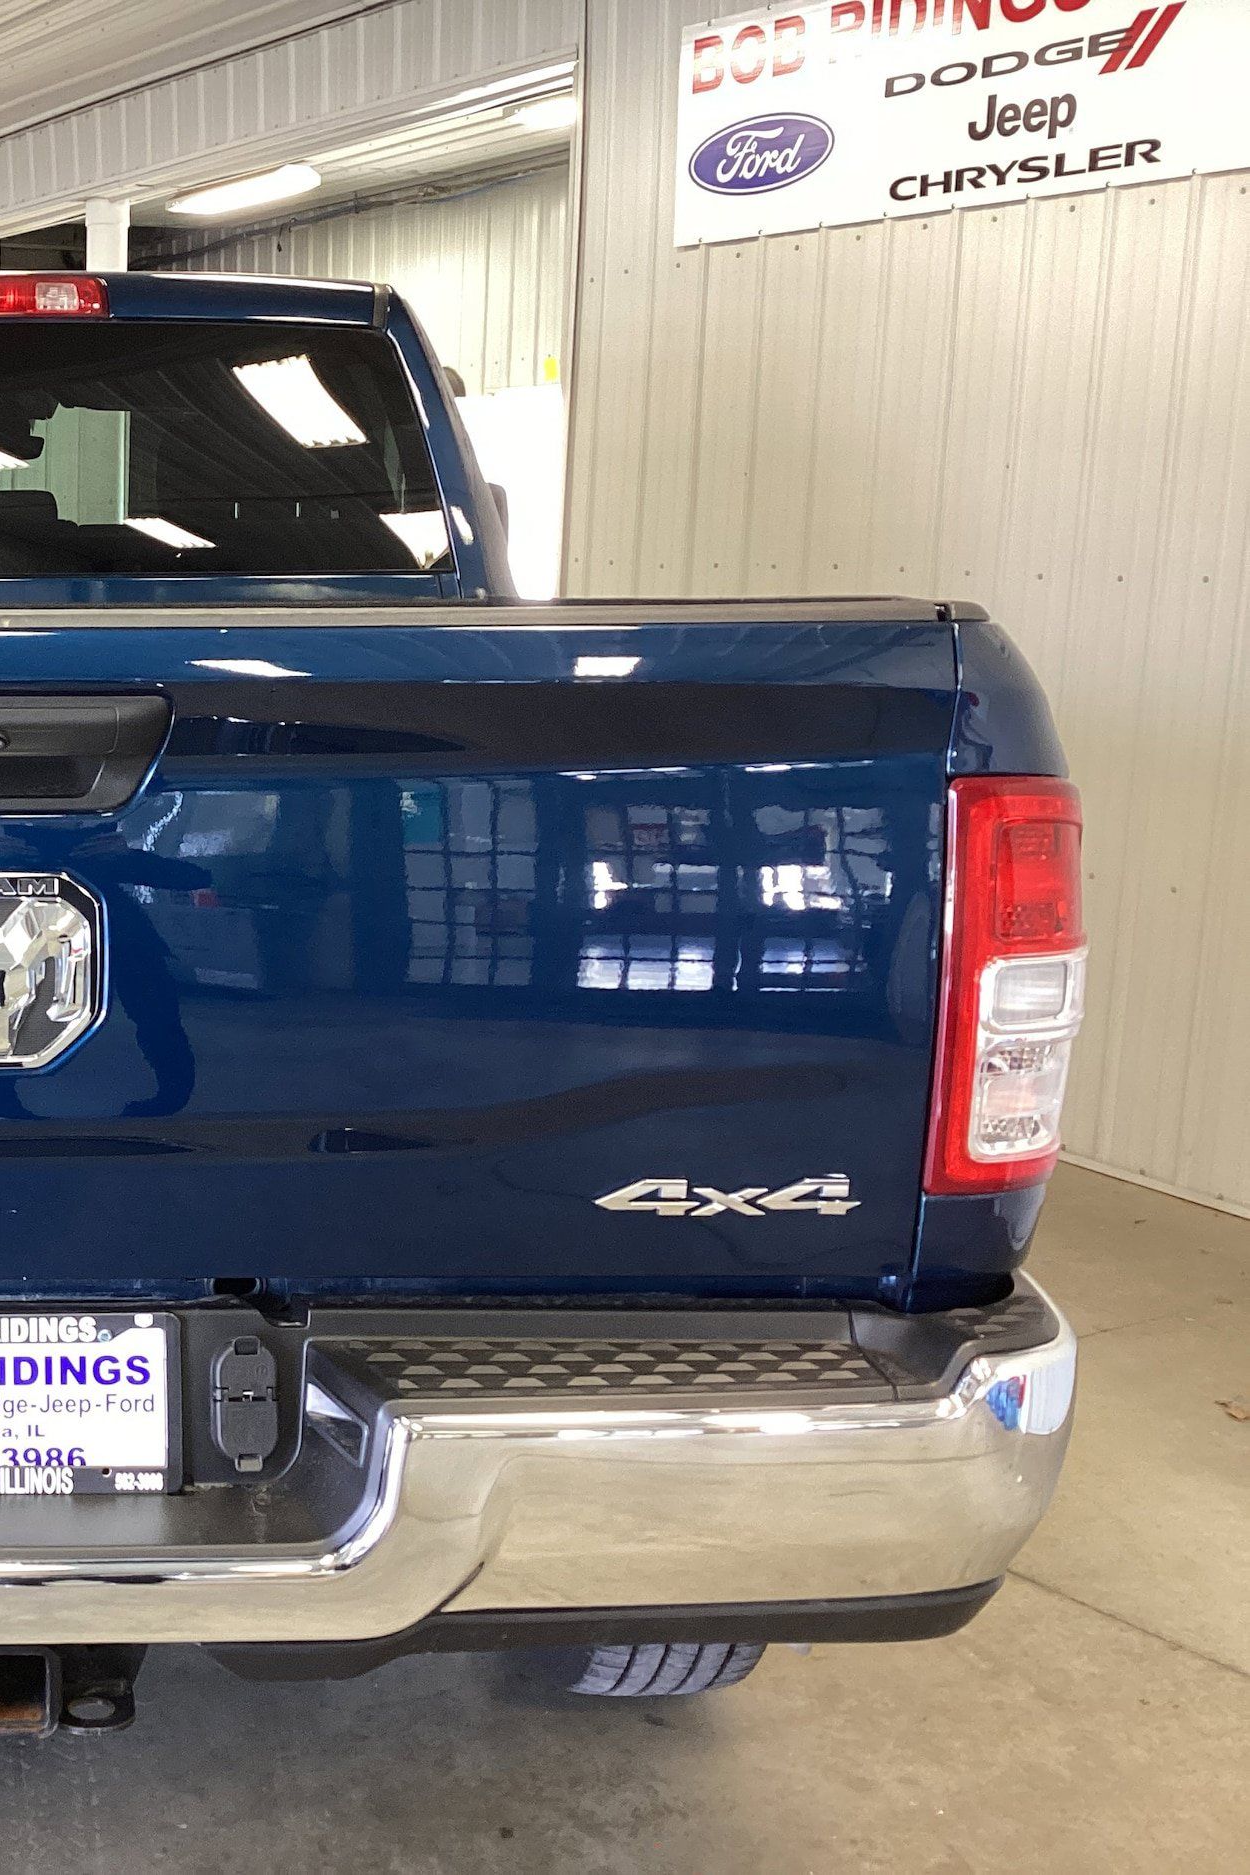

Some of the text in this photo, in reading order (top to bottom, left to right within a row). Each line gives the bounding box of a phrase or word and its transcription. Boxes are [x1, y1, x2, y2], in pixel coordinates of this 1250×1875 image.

[692, 0, 1091, 94] BOB RIDIN
[884, 27, 1134, 98] DODGE
[967, 93, 1077, 139] Jeep
[716, 127, 805, 189] Ford
[889, 138, 1162, 201] CHRYSLER
[27, 1424, 46, 1438] IL
[0, 1469, 74, 1495] ILLINOIS
